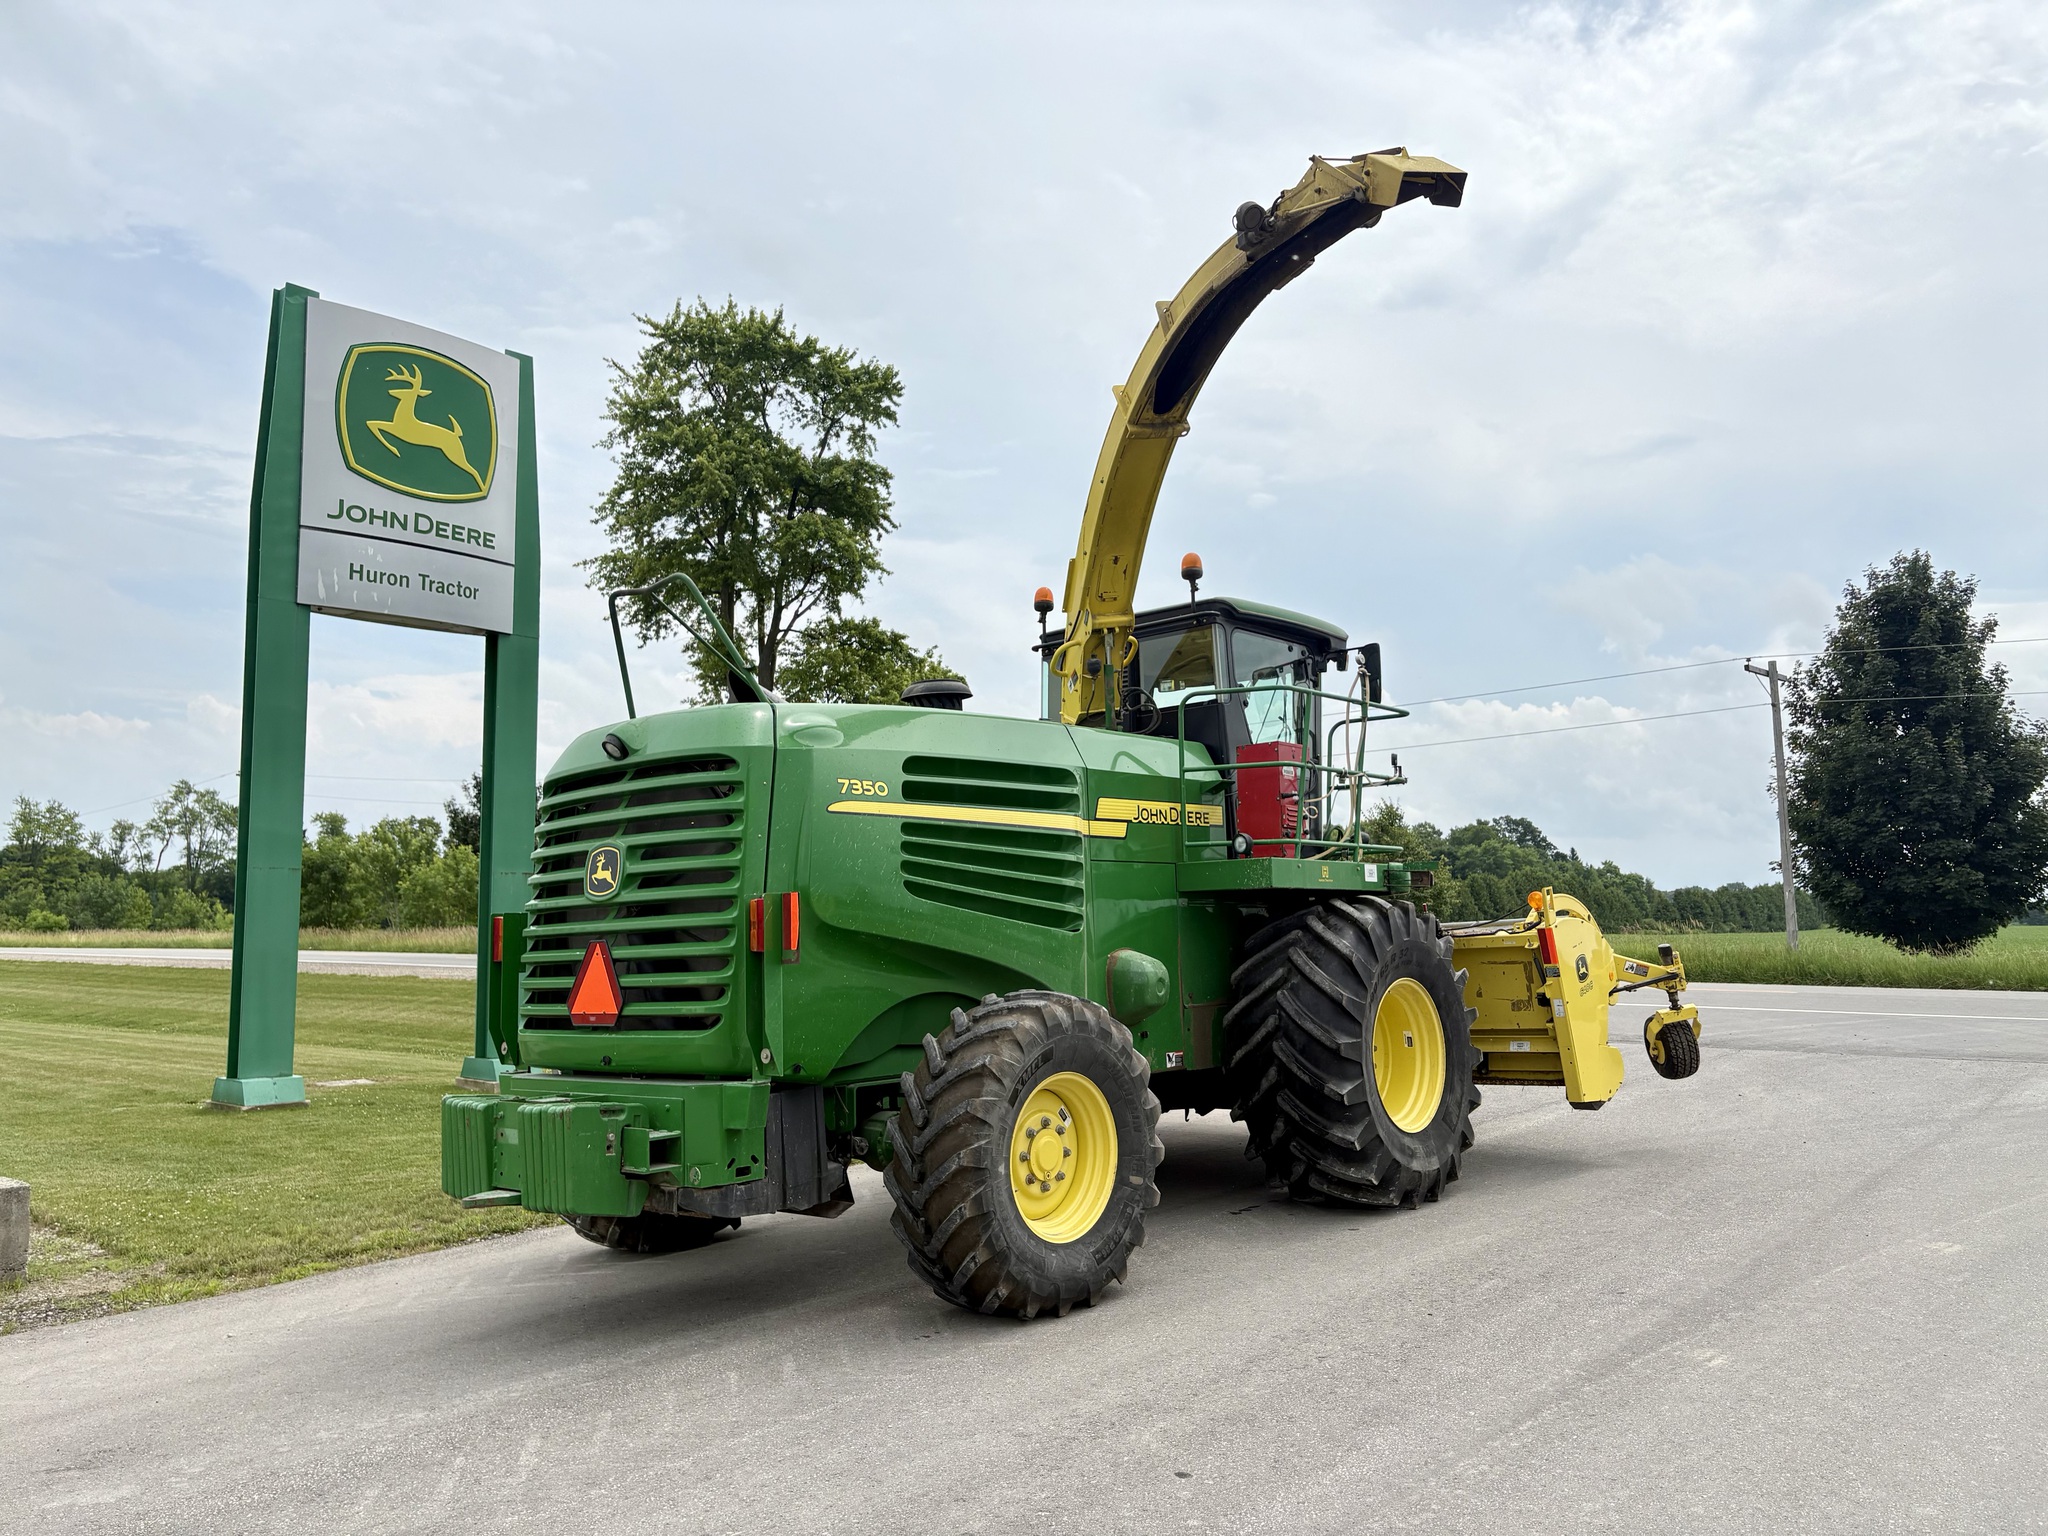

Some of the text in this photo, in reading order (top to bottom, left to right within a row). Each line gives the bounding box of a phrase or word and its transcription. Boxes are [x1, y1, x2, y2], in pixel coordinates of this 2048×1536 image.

[327, 499, 496, 550] JOHN DEERE
[349, 562, 479, 600] Huron Tractor
[837, 778, 889, 797] 7350
[1133, 805, 1210, 825] JOHN DERE
